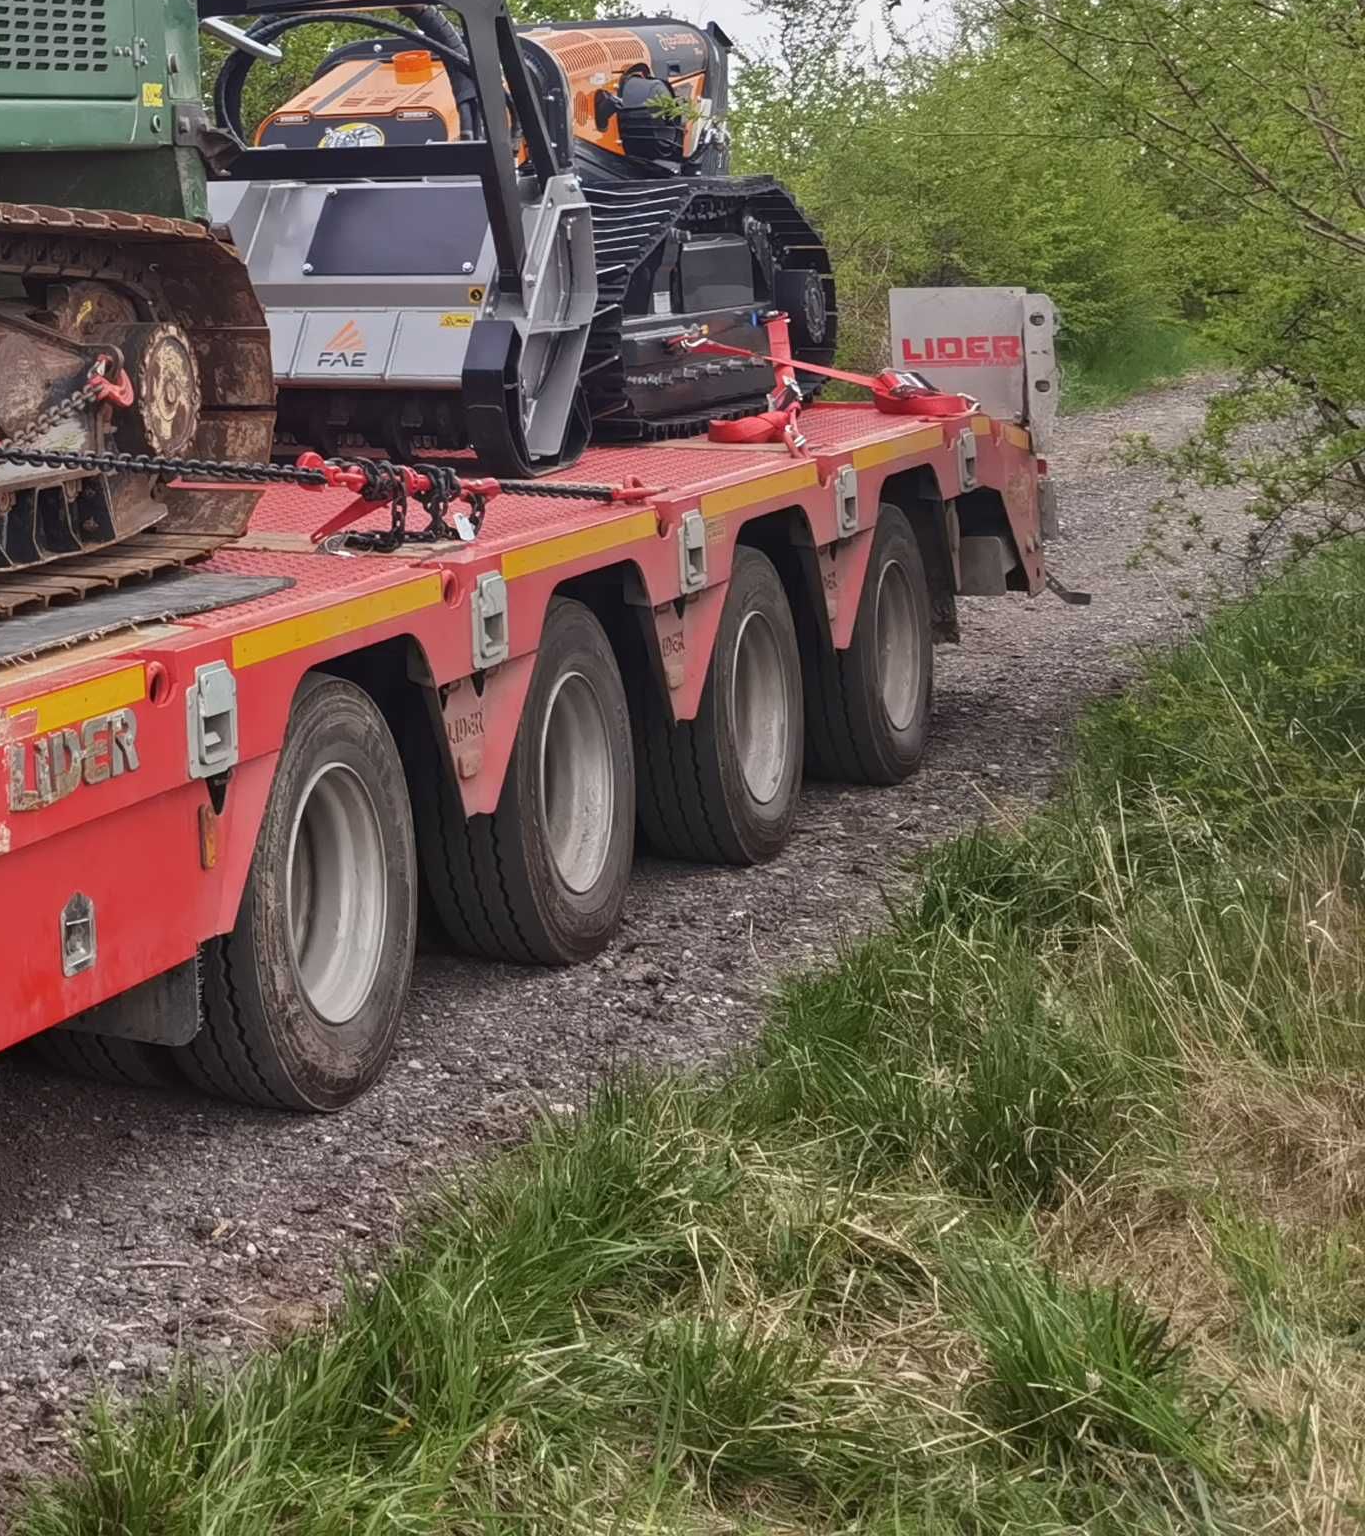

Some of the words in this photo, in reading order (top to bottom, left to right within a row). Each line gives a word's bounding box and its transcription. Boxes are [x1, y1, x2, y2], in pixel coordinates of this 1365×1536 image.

[317, 352, 367, 367] FAE
[902, 335, 1021, 361] LIDER
[7, 707, 140, 811] LIDER
